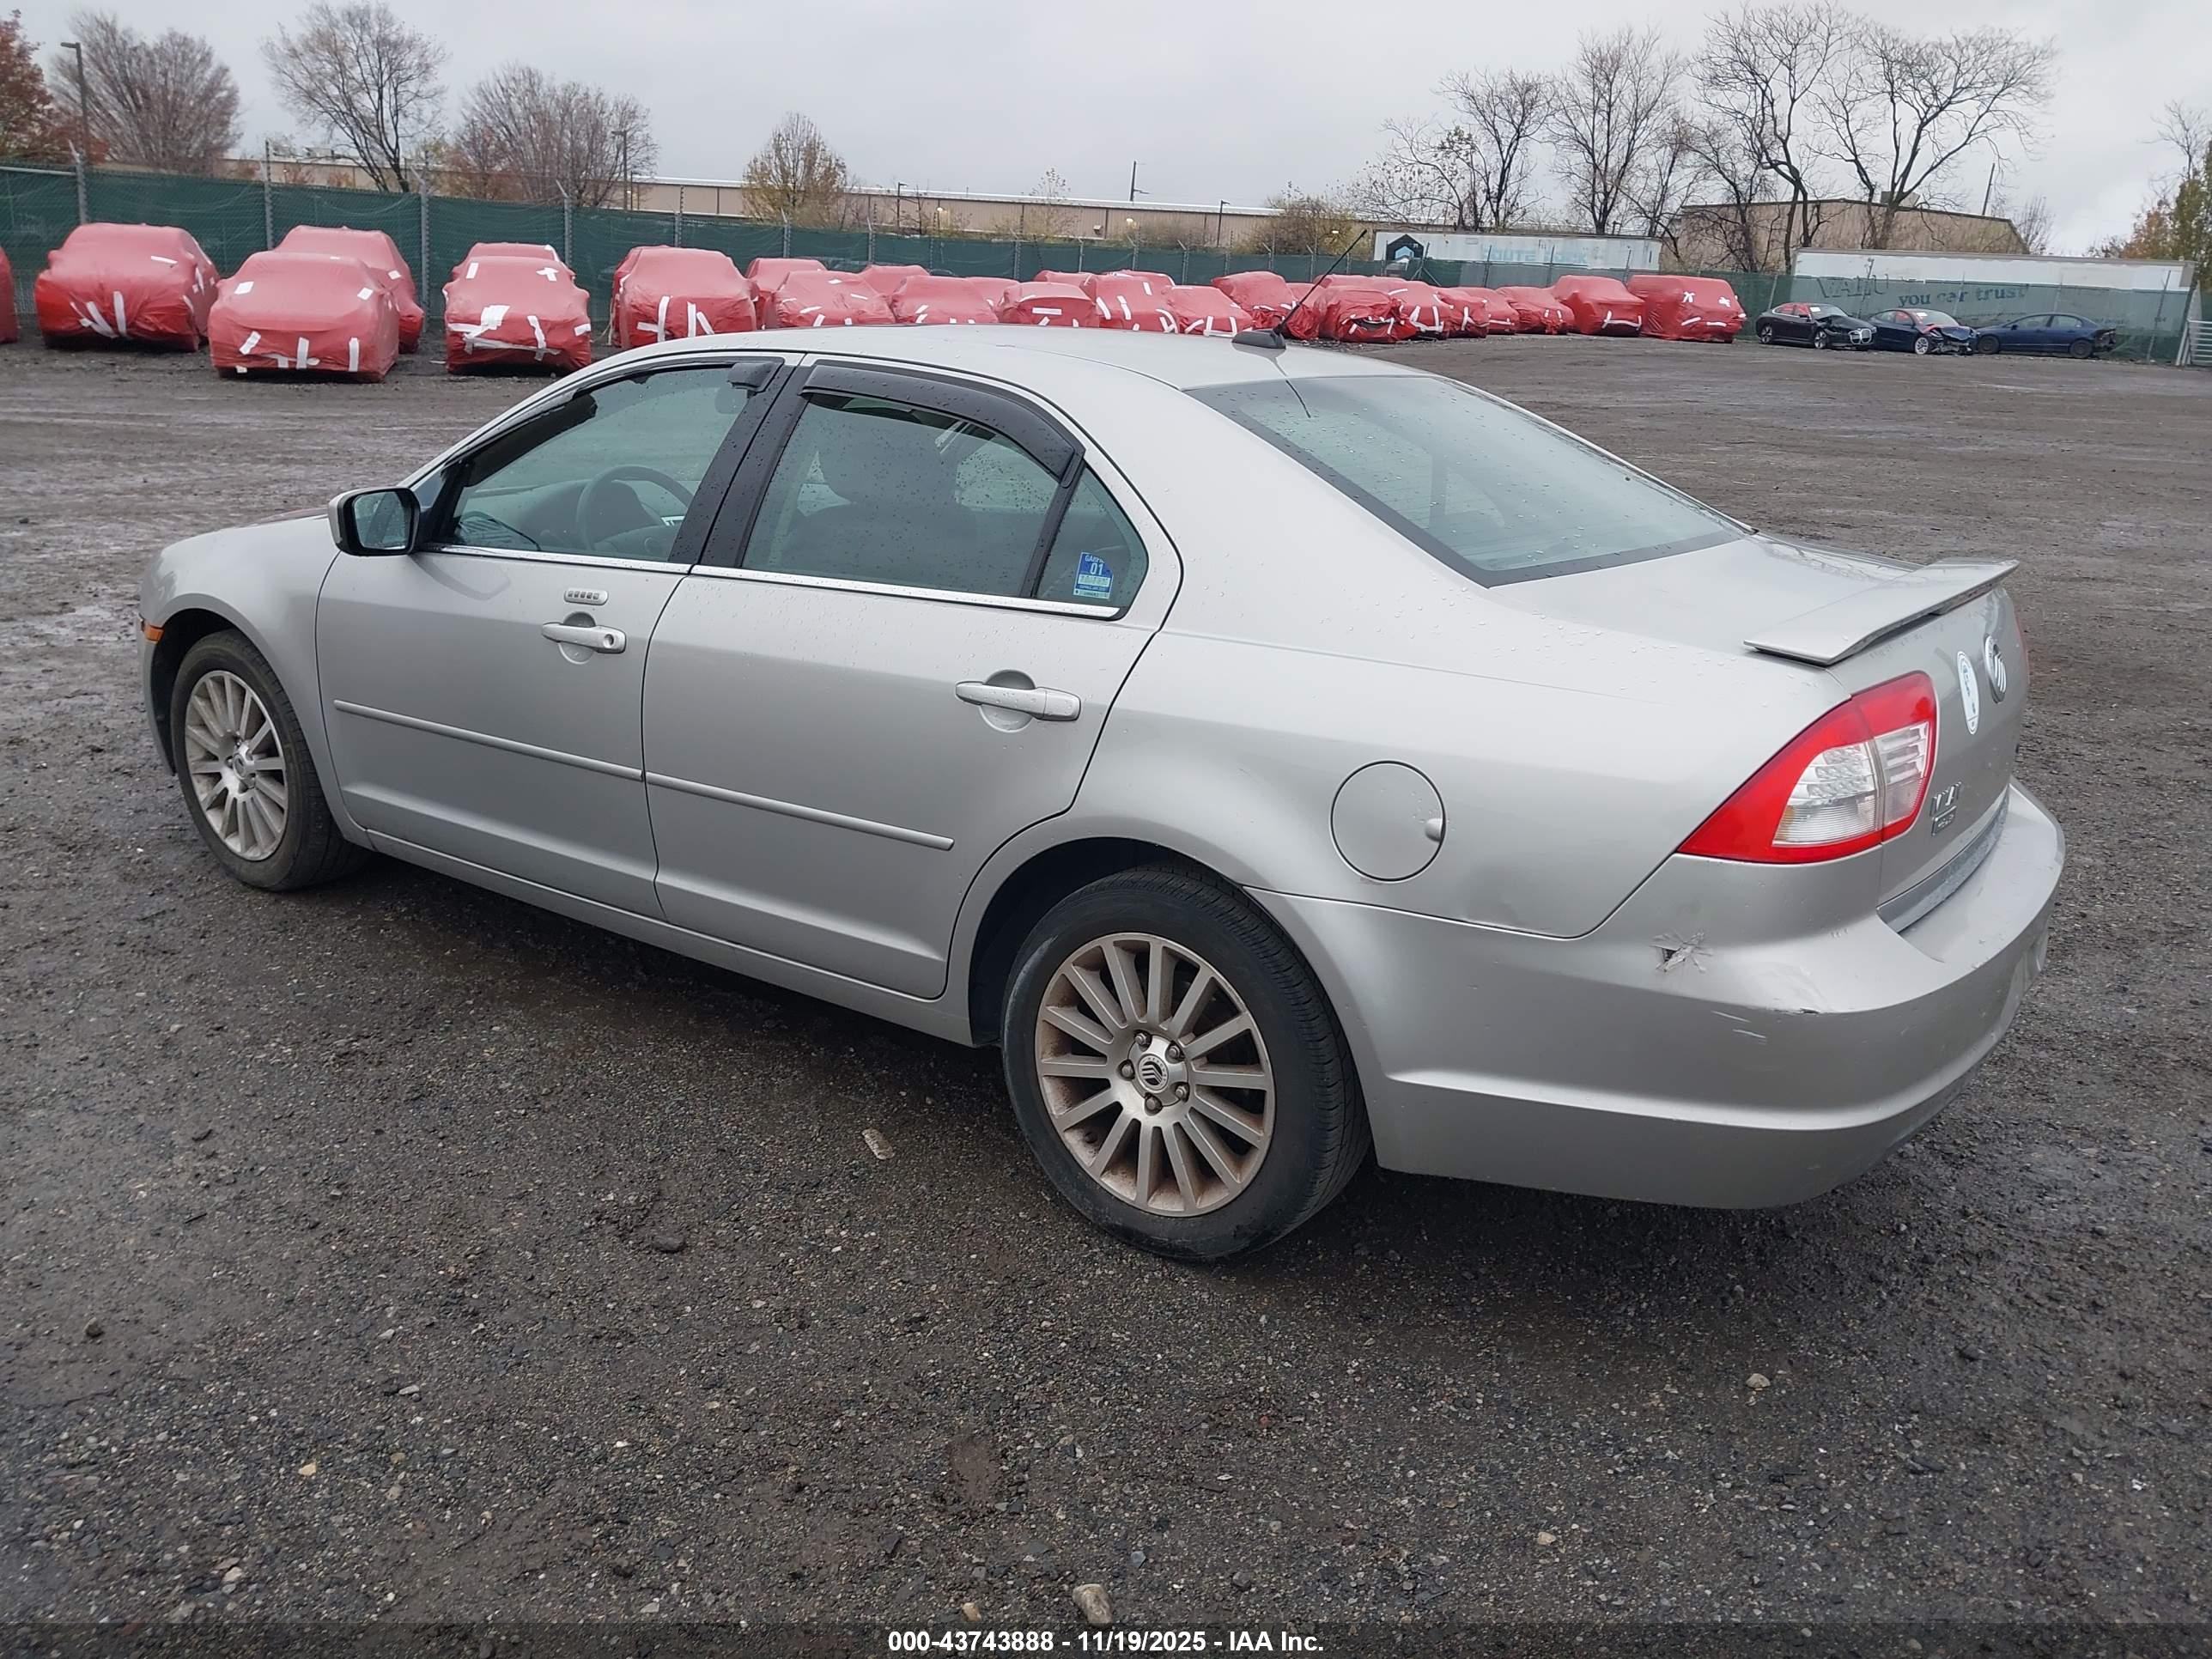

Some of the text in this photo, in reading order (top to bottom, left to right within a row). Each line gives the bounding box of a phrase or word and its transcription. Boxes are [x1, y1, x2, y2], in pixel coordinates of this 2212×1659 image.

[1898, 293, 1931, 308] you
[1977, 286, 2027, 301] trust
[1090, 562, 1103, 575] 01
